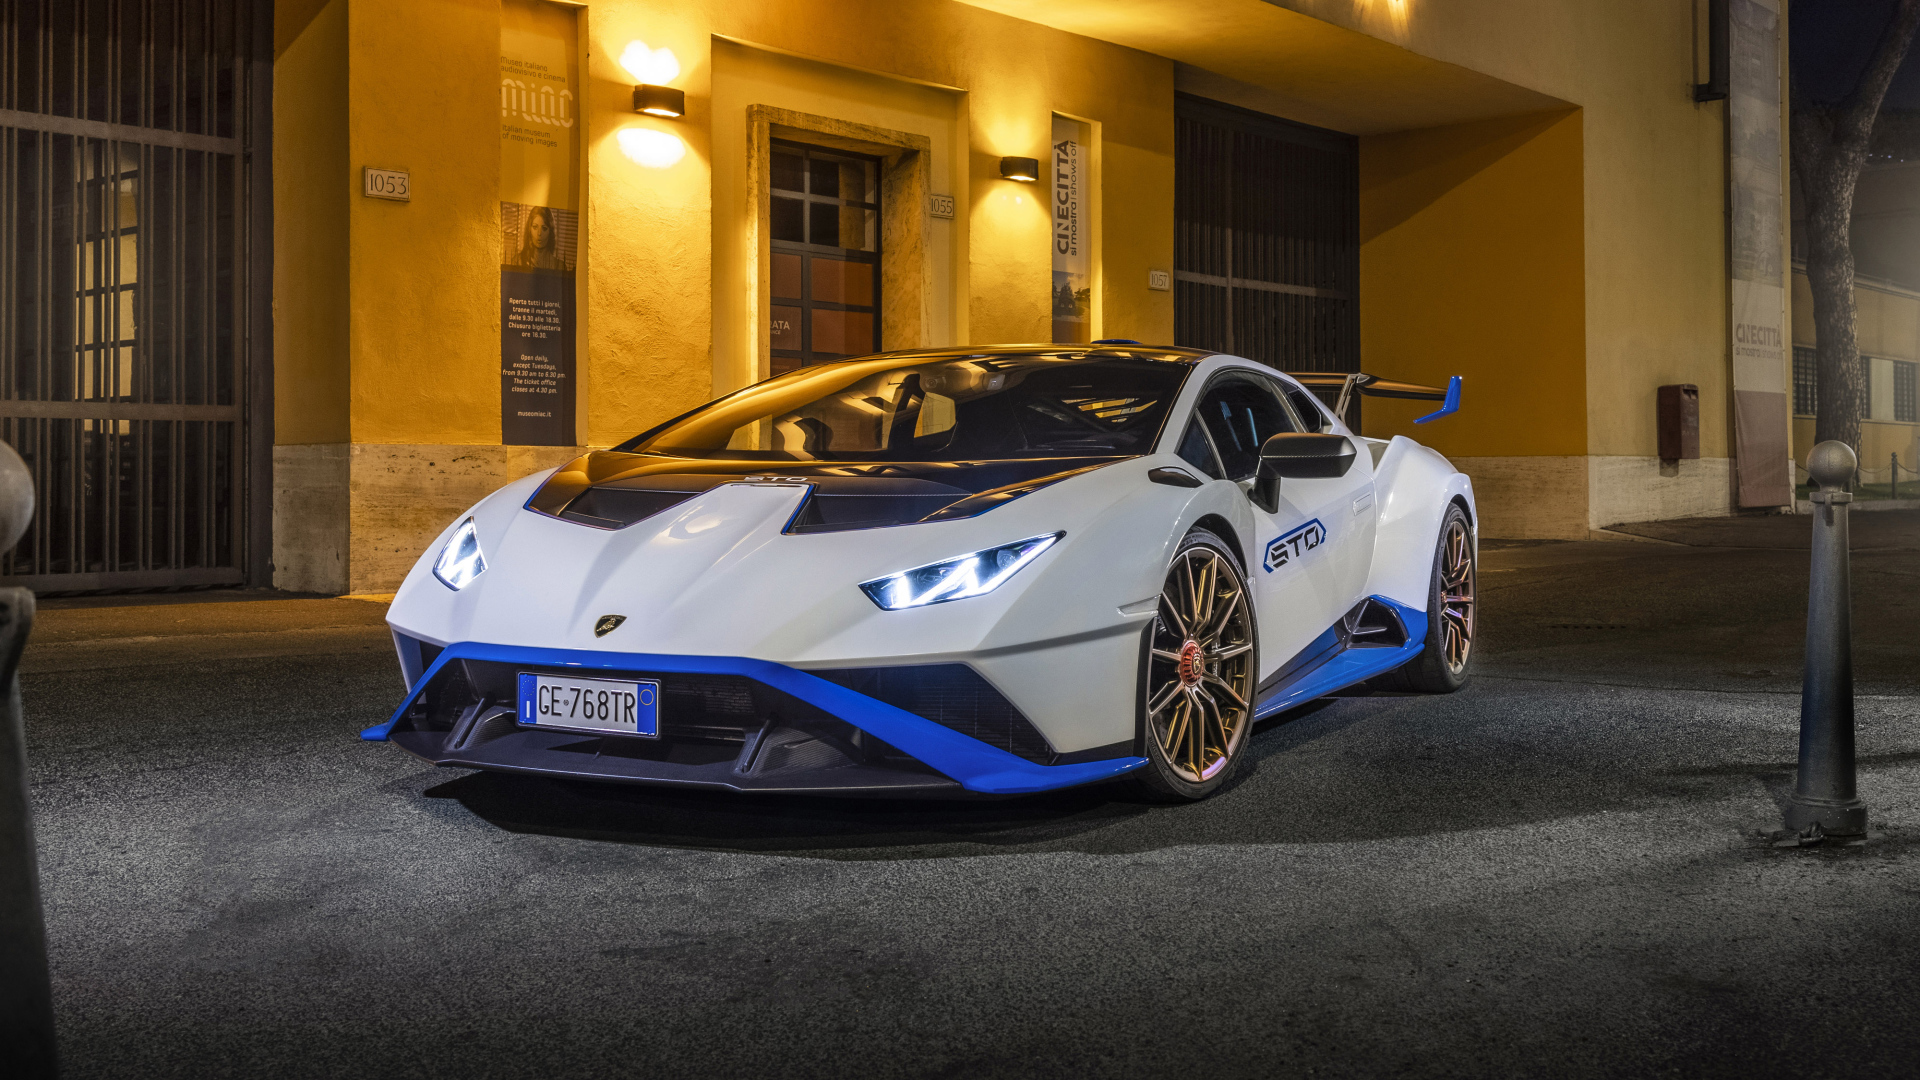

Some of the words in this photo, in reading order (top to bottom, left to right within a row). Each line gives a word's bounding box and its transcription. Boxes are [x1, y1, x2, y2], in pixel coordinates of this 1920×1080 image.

[524, 61, 548, 72] italiano
[501, 65, 537, 77] audiovisivo
[544, 73, 566, 83] cinema
[524, 128, 551, 138] museum
[502, 132, 509, 140] of
[511, 134, 534, 144] moving
[536, 137, 558, 147] images
[370, 173, 407, 195] 1053
[931, 198, 953, 214] 1055
[1070, 247, 1077, 256] si
[1151, 273, 1168, 287] 1057
[509, 297, 527, 305] Aperto
[532, 323, 561, 332] biglietteria
[521, 353, 534, 361] Open
[1271, 525, 1320, 569] STO
